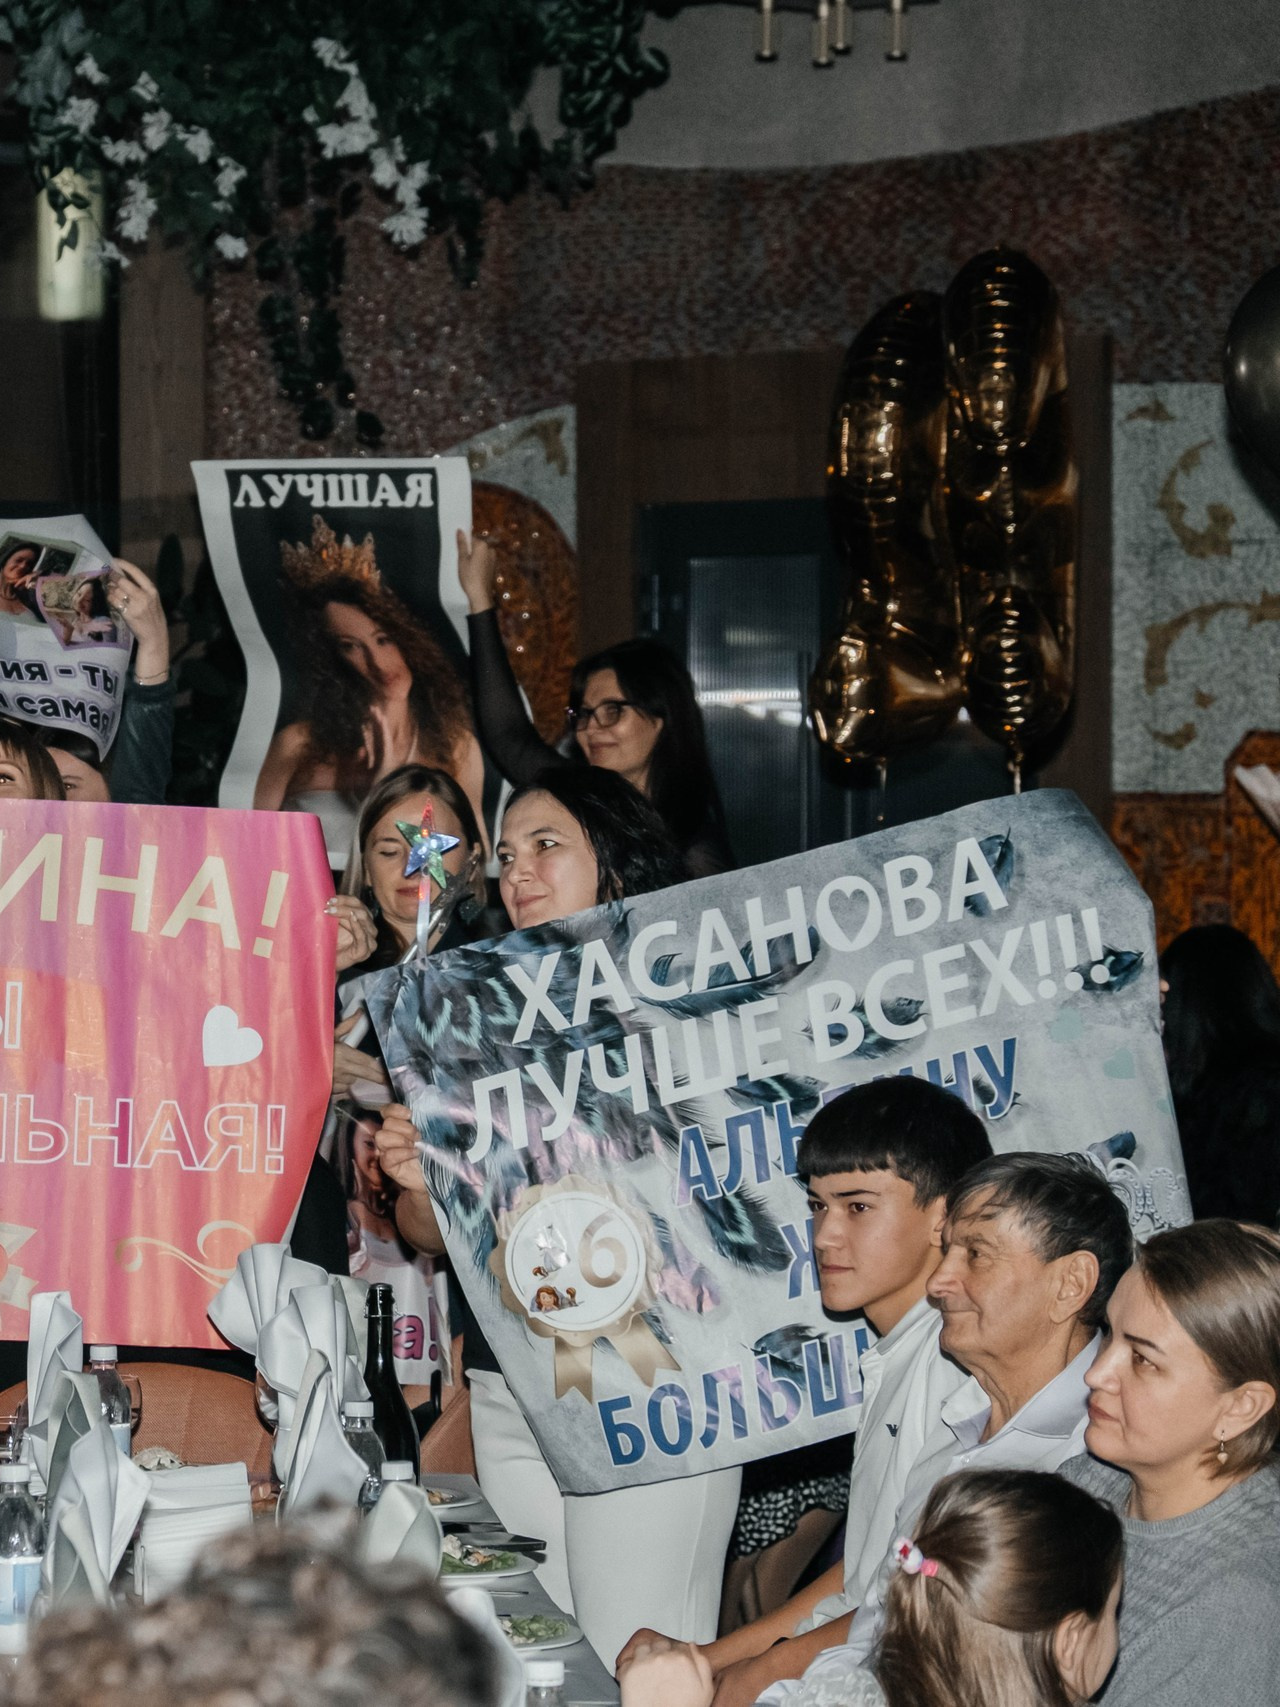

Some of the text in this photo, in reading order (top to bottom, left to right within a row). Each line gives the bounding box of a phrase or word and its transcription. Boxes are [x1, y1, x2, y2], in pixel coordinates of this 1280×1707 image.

[233, 473, 434, 508] ЛУЧШАЯ
[503, 836, 1009, 1044] ХАСАНОВА
[466, 906, 1110, 1164] ЛУЧШЕ ВСЕХ!!!
[675, 1035, 1018, 1207] АЛЬНУ
[597, 1326, 869, 1468] БОЛЬШ
